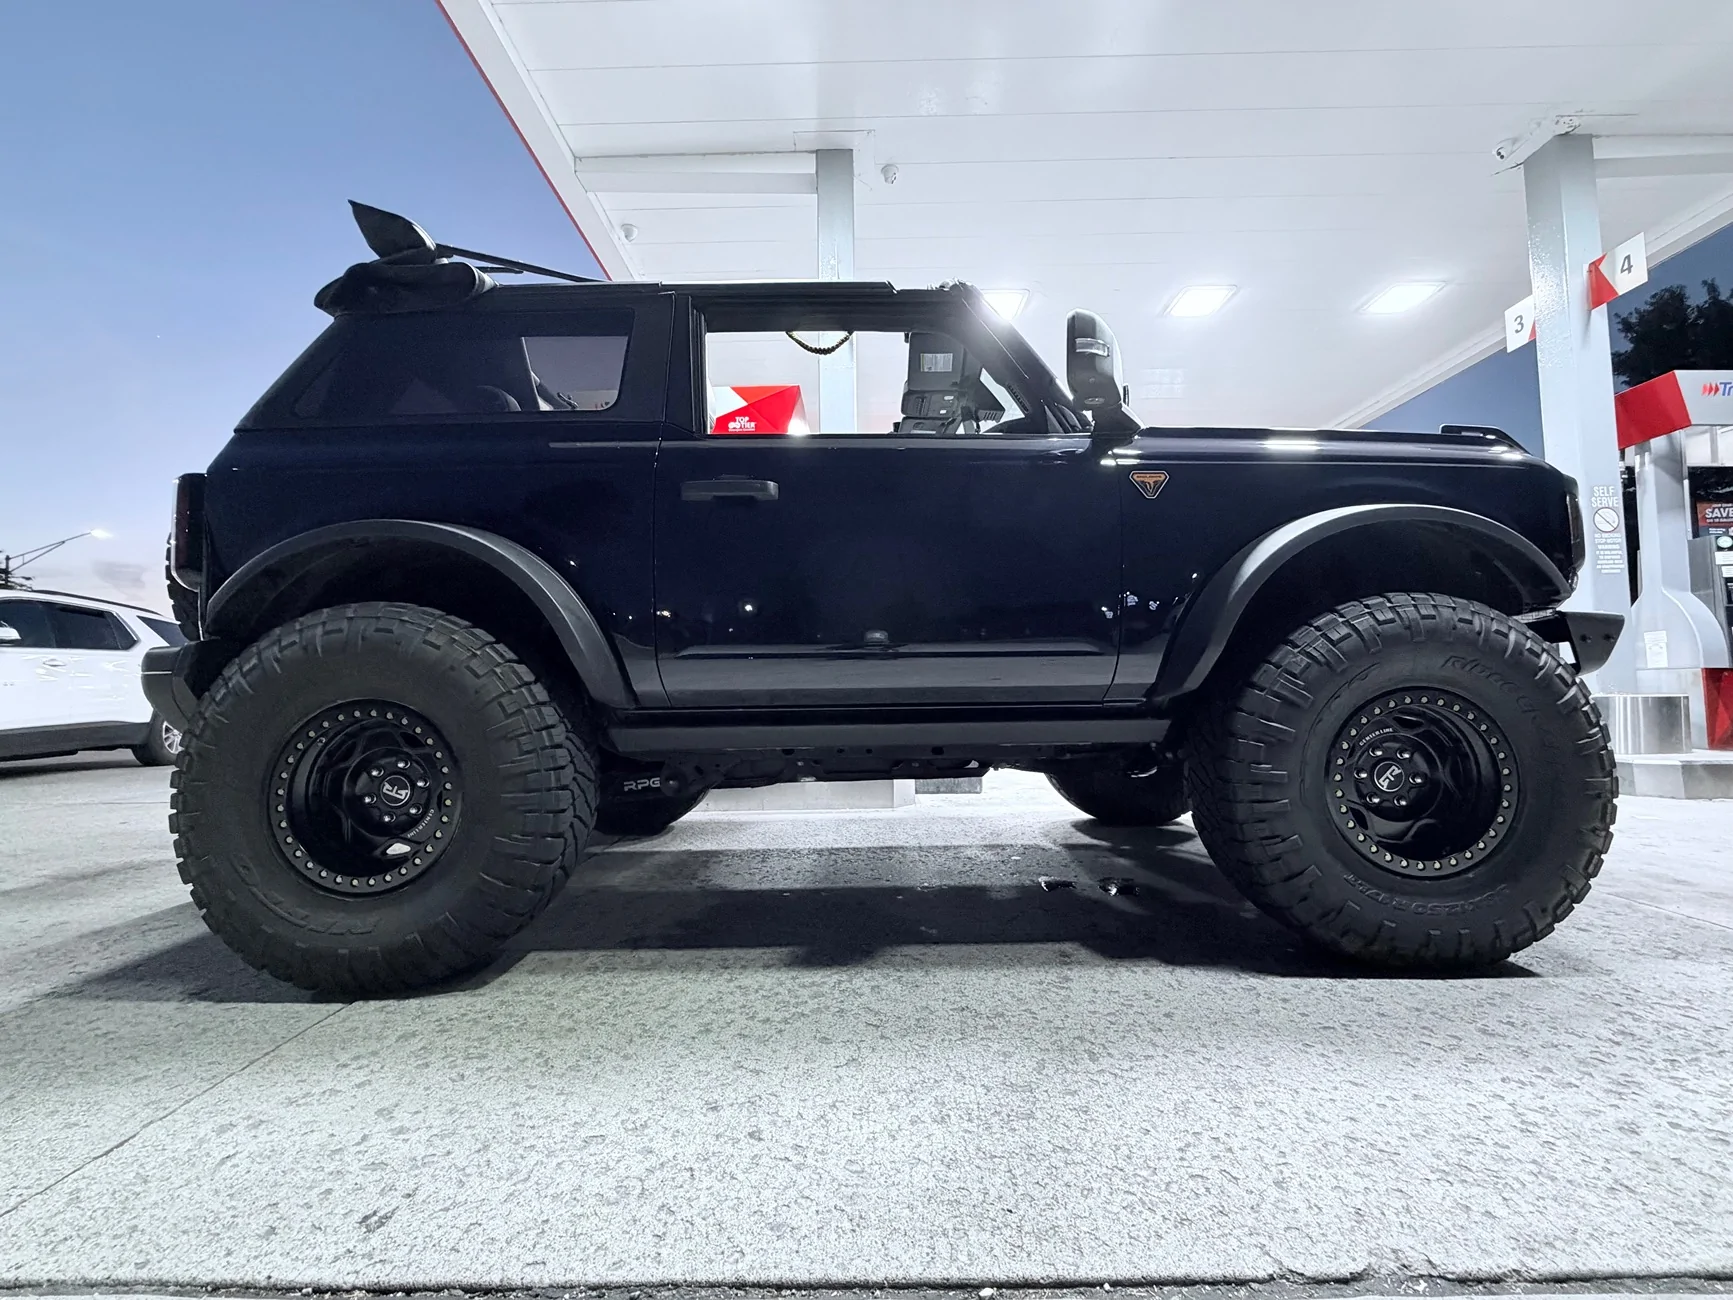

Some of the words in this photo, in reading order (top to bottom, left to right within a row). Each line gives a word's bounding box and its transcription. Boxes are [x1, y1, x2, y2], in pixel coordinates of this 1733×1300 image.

[1620, 253, 1634, 275] 4
[1513, 314, 1525, 334] 3
[1593, 486, 1615, 497] SELF
[1591, 497, 1619, 508] SERVE
[623, 777, 661, 792] RPG
